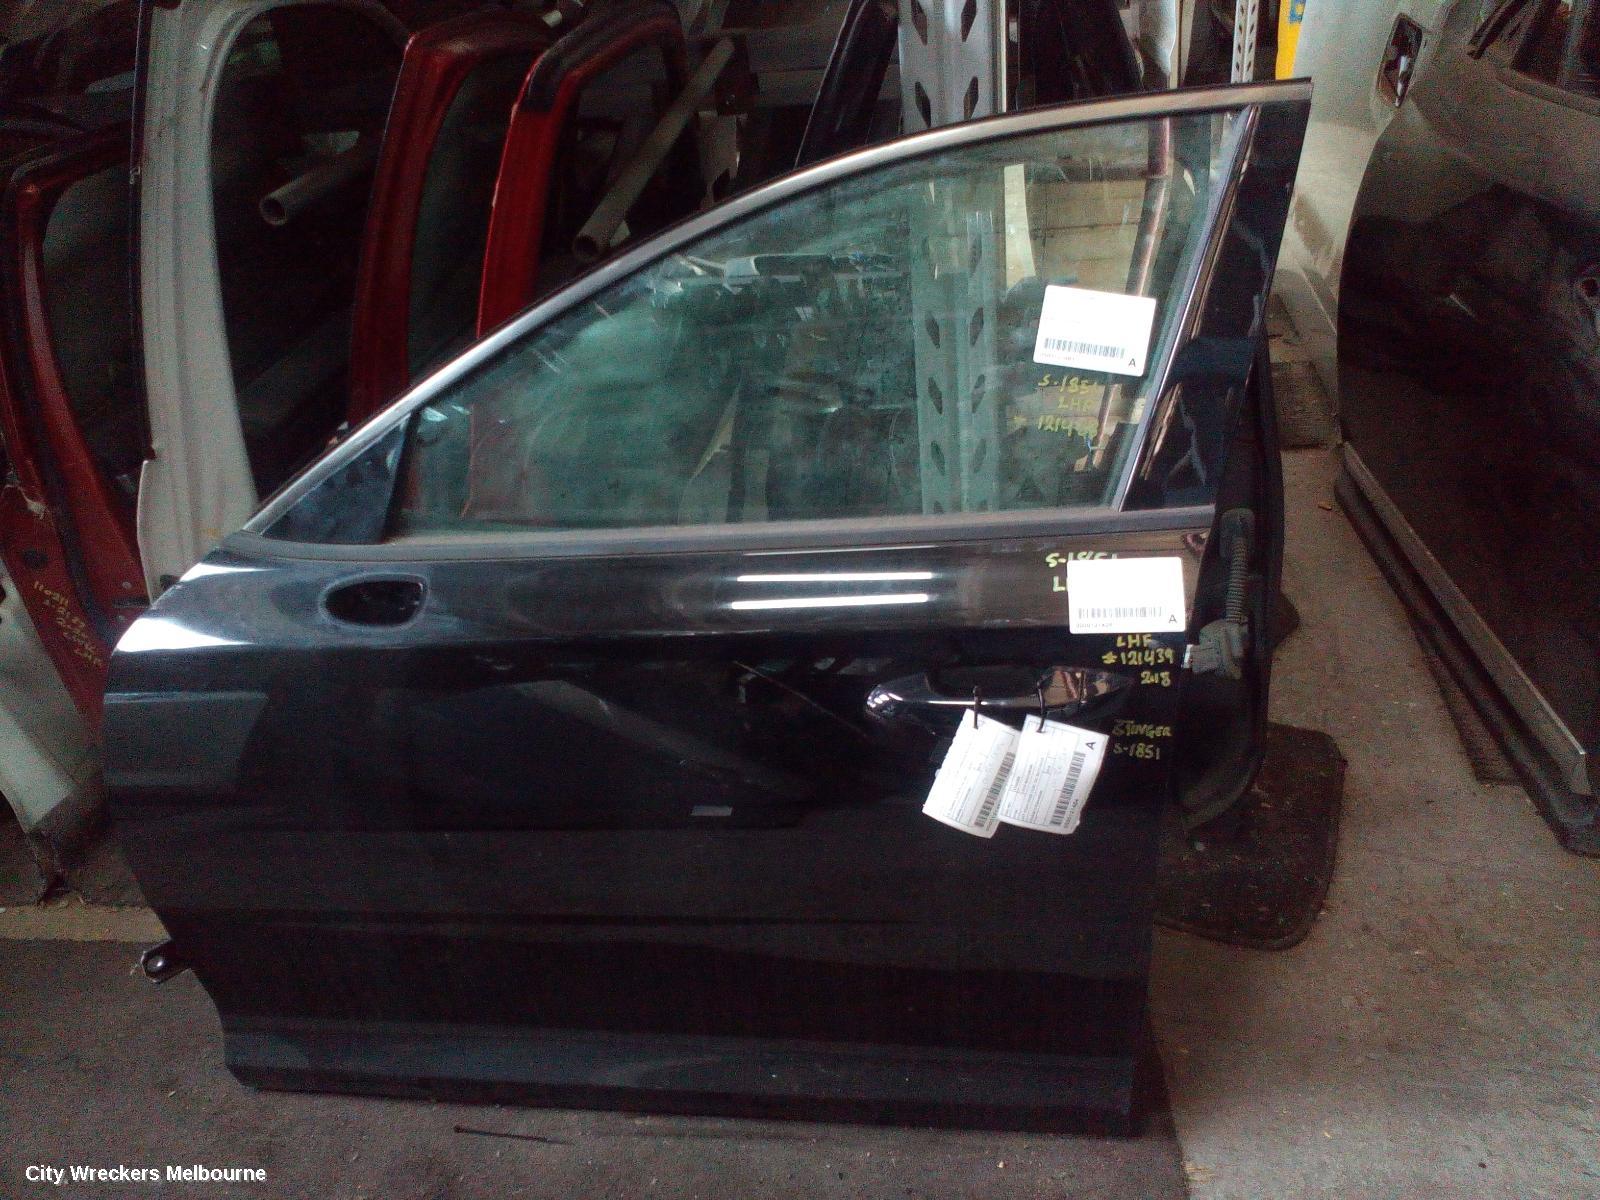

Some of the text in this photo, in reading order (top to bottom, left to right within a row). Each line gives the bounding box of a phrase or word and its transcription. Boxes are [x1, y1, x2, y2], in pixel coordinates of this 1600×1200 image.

[1127, 357, 1137, 367] A
[1168, 614, 1178, 624] A
[1116, 634, 1153, 648] LHF
[1085, 741, 1096, 750] A
[1113, 742, 1161, 760] S-1851
